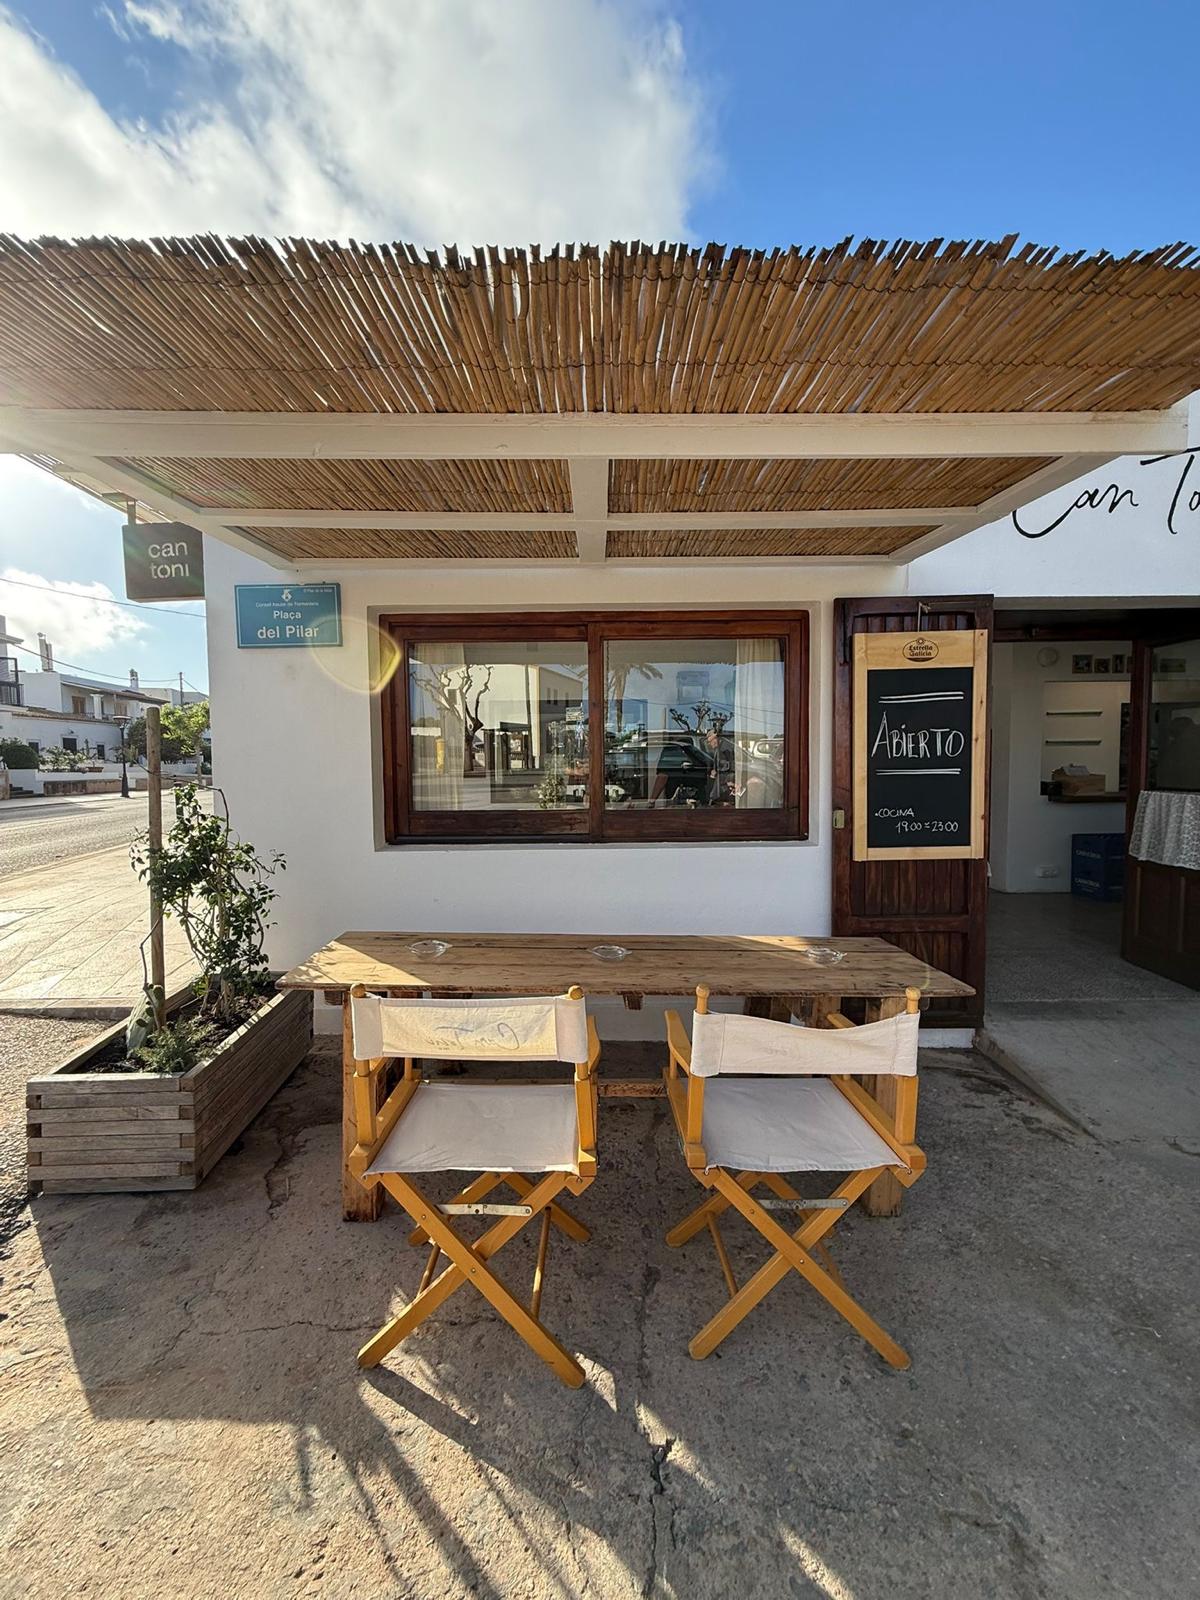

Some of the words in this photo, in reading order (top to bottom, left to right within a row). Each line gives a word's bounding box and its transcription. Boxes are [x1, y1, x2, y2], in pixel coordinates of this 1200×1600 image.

[148, 542, 188, 558] can
[150, 563, 190, 578] toni
[273, 610, 302, 620] Plaça
[257, 626, 280, 639] del
[285, 625, 319, 638] Pilar
